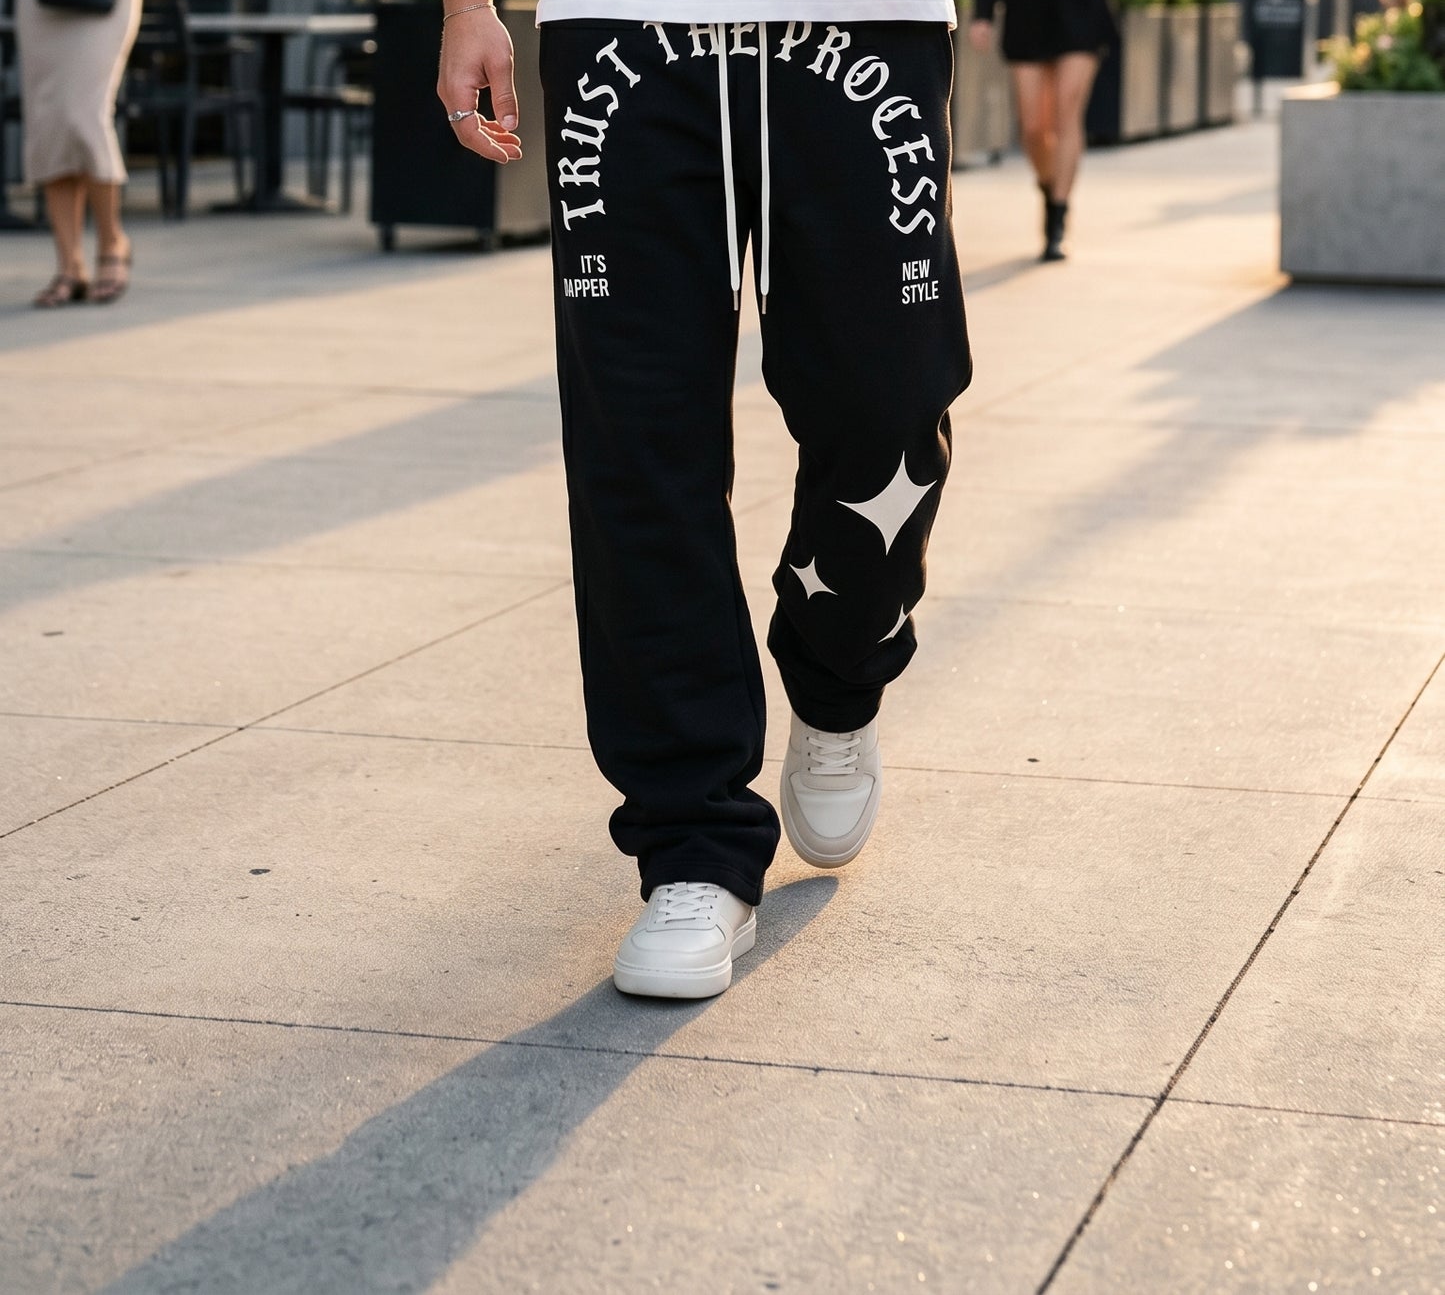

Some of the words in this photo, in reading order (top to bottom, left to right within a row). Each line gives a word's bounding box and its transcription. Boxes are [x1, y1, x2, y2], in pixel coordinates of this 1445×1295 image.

[557, 37, 641, 231] TRUST
[642, 21, 759, 65] THE
[774, 20, 938, 236] PROCESS
[580, 254, 607, 274] IT'S
[902, 258, 931, 282] NEW
[901, 280, 939, 305] STYLE
